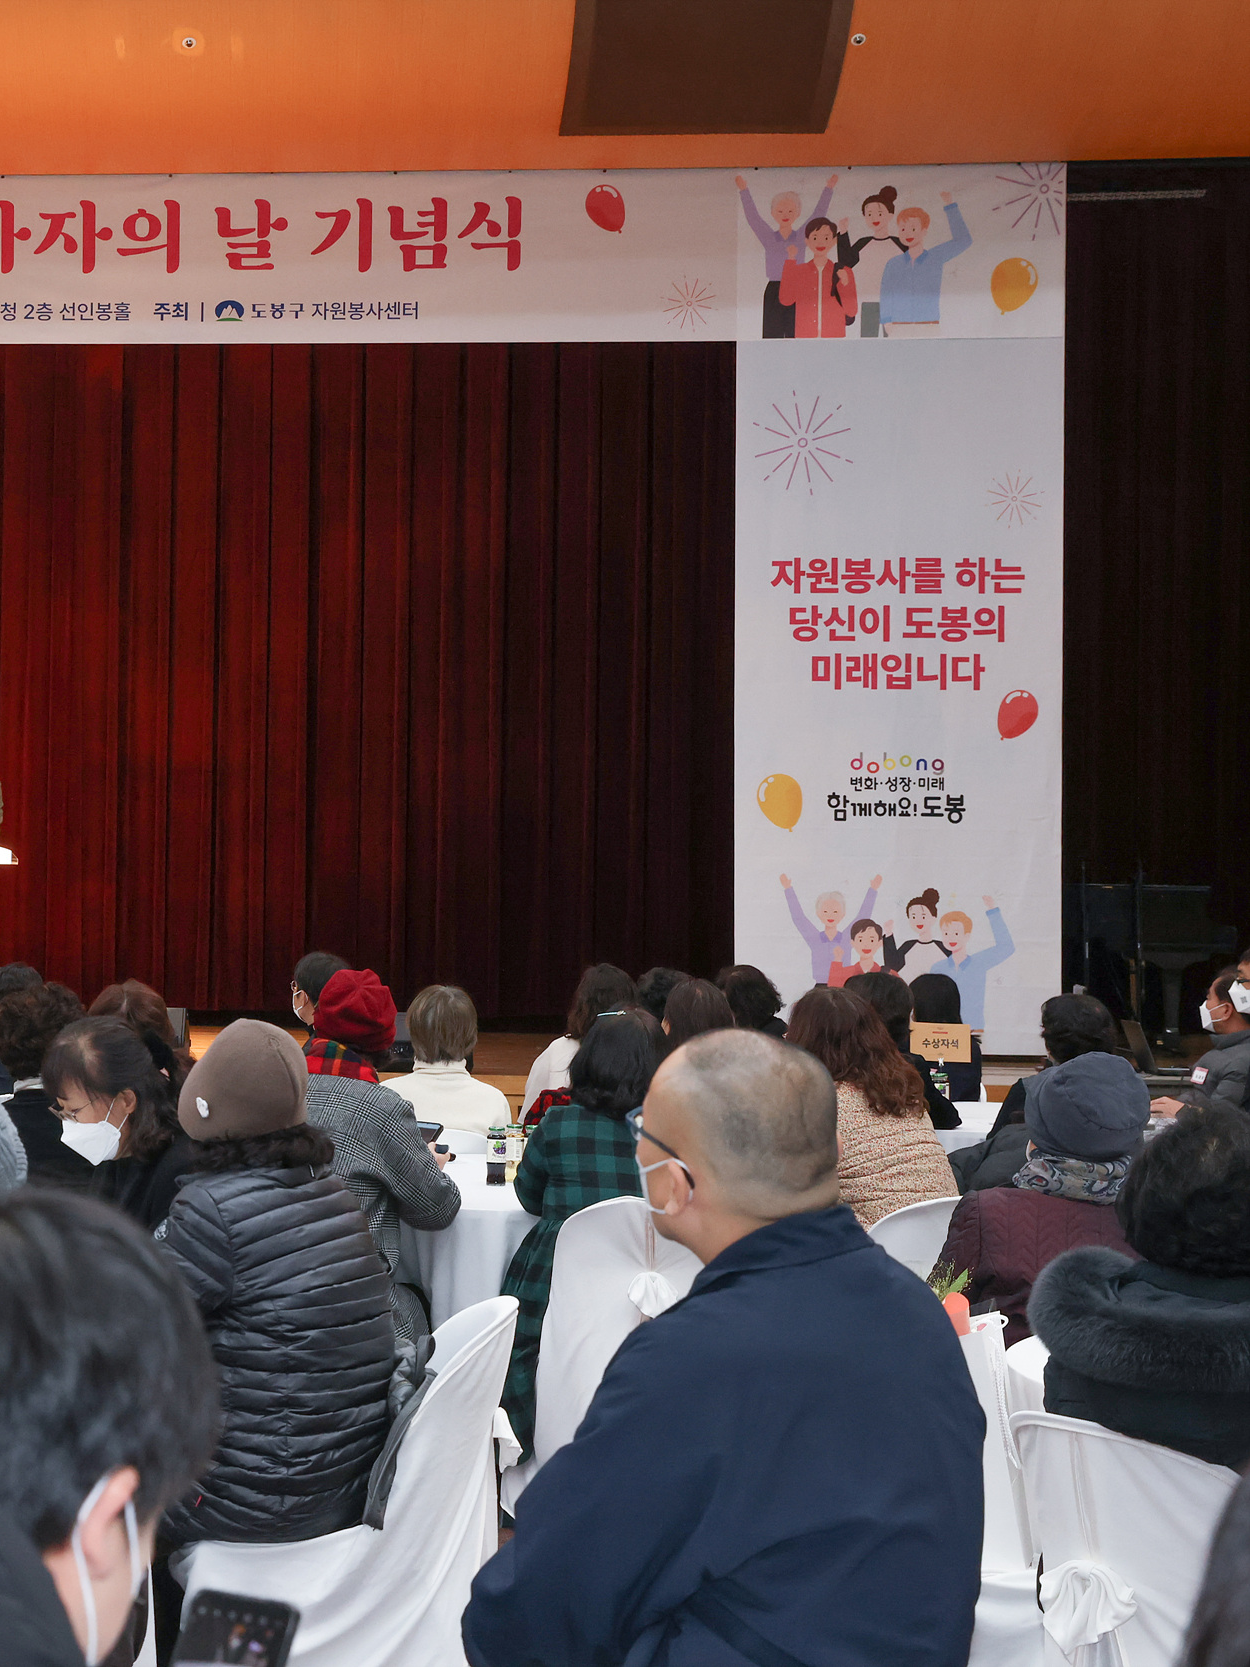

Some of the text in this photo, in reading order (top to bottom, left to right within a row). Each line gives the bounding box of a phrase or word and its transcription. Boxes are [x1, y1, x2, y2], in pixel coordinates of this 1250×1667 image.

[215, 198, 288, 270] 날
[311, 196, 522, 273] 기념식
[23, 302, 53, 321] 2층
[59, 301, 131, 321] 선인봉홀
[153, 301, 419, 321] 주최 도봉구 자원봉사센터
[770, 556, 1026, 595] 자원봉사를 하는
[789, 605, 1006, 643] 당신이 도봉의
[811, 653, 986, 691] 미래입니다
[850, 752, 945, 775] dobong
[922, 1037, 959, 1050] 수상자석
